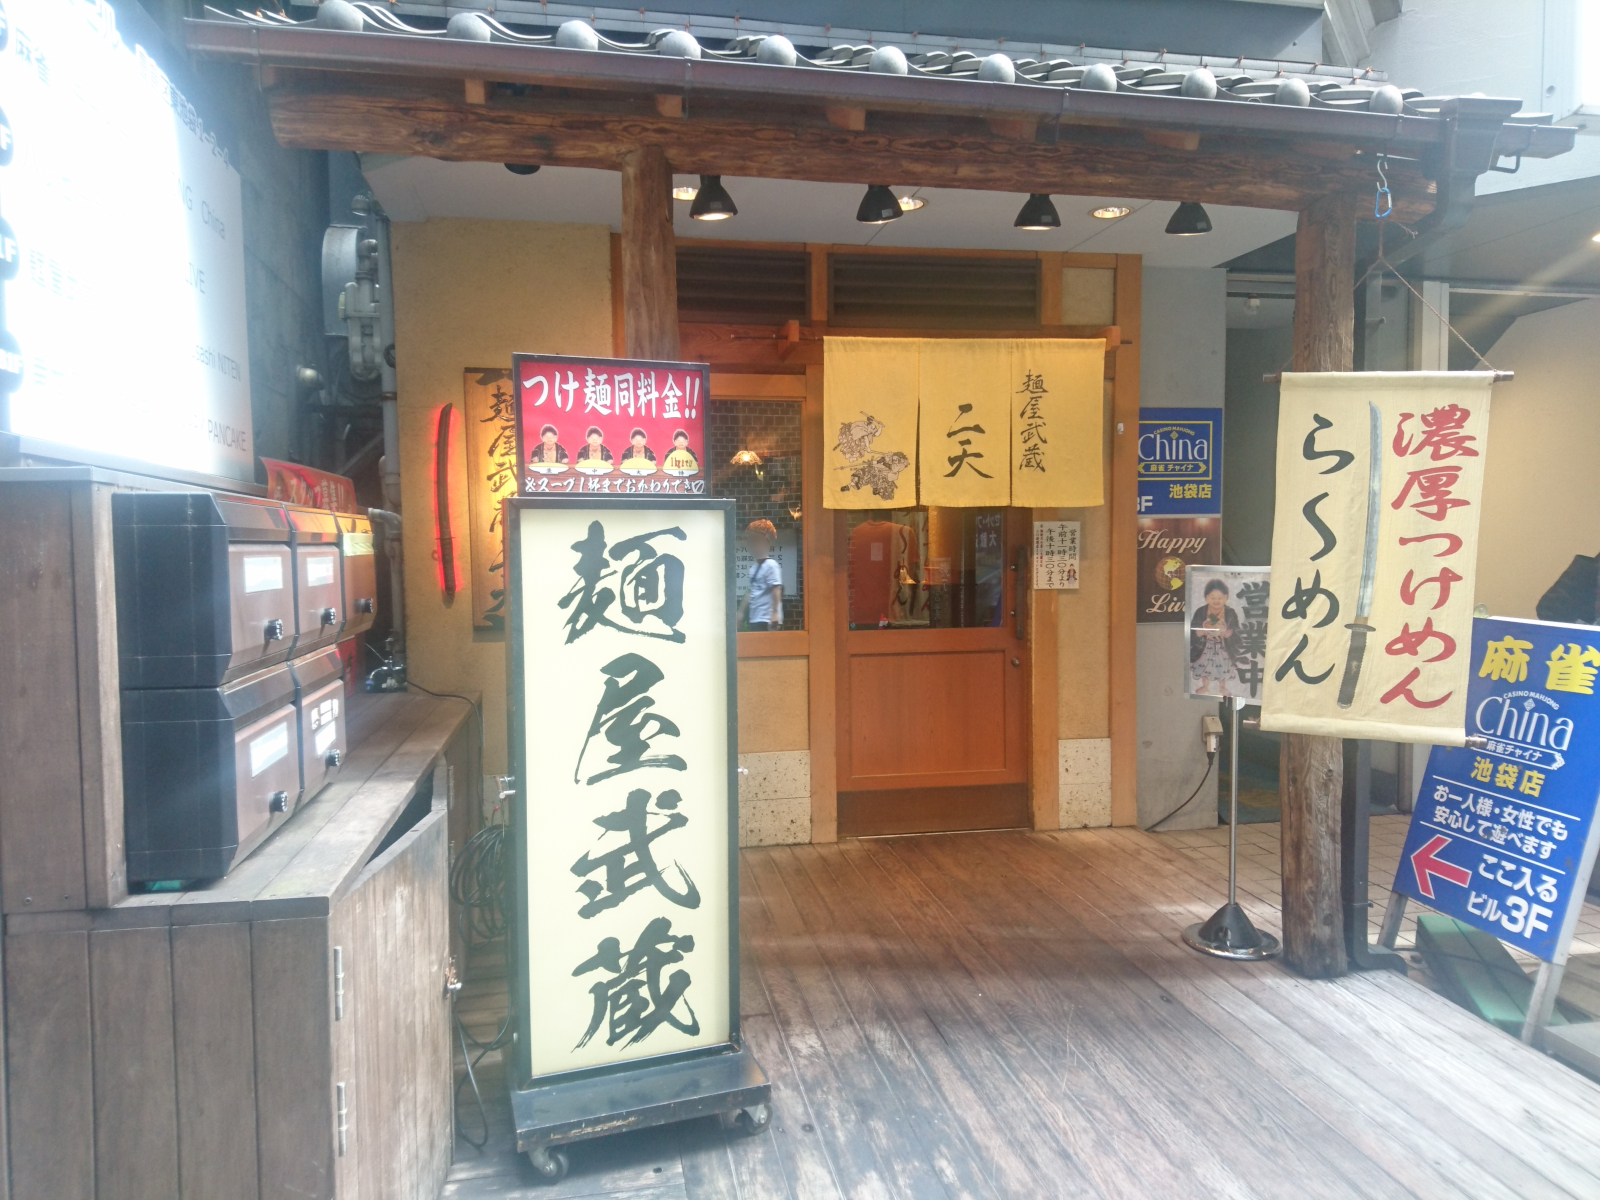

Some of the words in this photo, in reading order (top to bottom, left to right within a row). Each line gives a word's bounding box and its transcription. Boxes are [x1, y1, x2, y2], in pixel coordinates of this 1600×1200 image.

[207, 418, 247, 452] PANCAKE
[943, 403, 994, 479] 二天
[1138, 433, 1208, 461] China
[1169, 483, 1212, 499] 池袋店
[1069, 528, 1078, 561] 営業時間
[1137, 529, 1207, 554] Happy
[1380, 404, 1480, 709] 濃厚つけめん
[1146, 593, 1186, 613] Liv
[1478, 635, 1600, 695] 麻雀
[1503, 690, 1529, 699] CASINO
[1529, 691, 1560, 711] MAHJONG
[1475, 696, 1575, 751] China
[1486, 740, 1543, 763] 麻雀チャイナ
[558, 520, 701, 1053] 麺屋武蔵
[1470, 756, 1545, 798] 池袋店
[1434, 805, 1557, 861] 安心して遊べます
[1478, 854, 1559, 903] ここ入る
[1467, 890, 1554, 939] ビル3F
